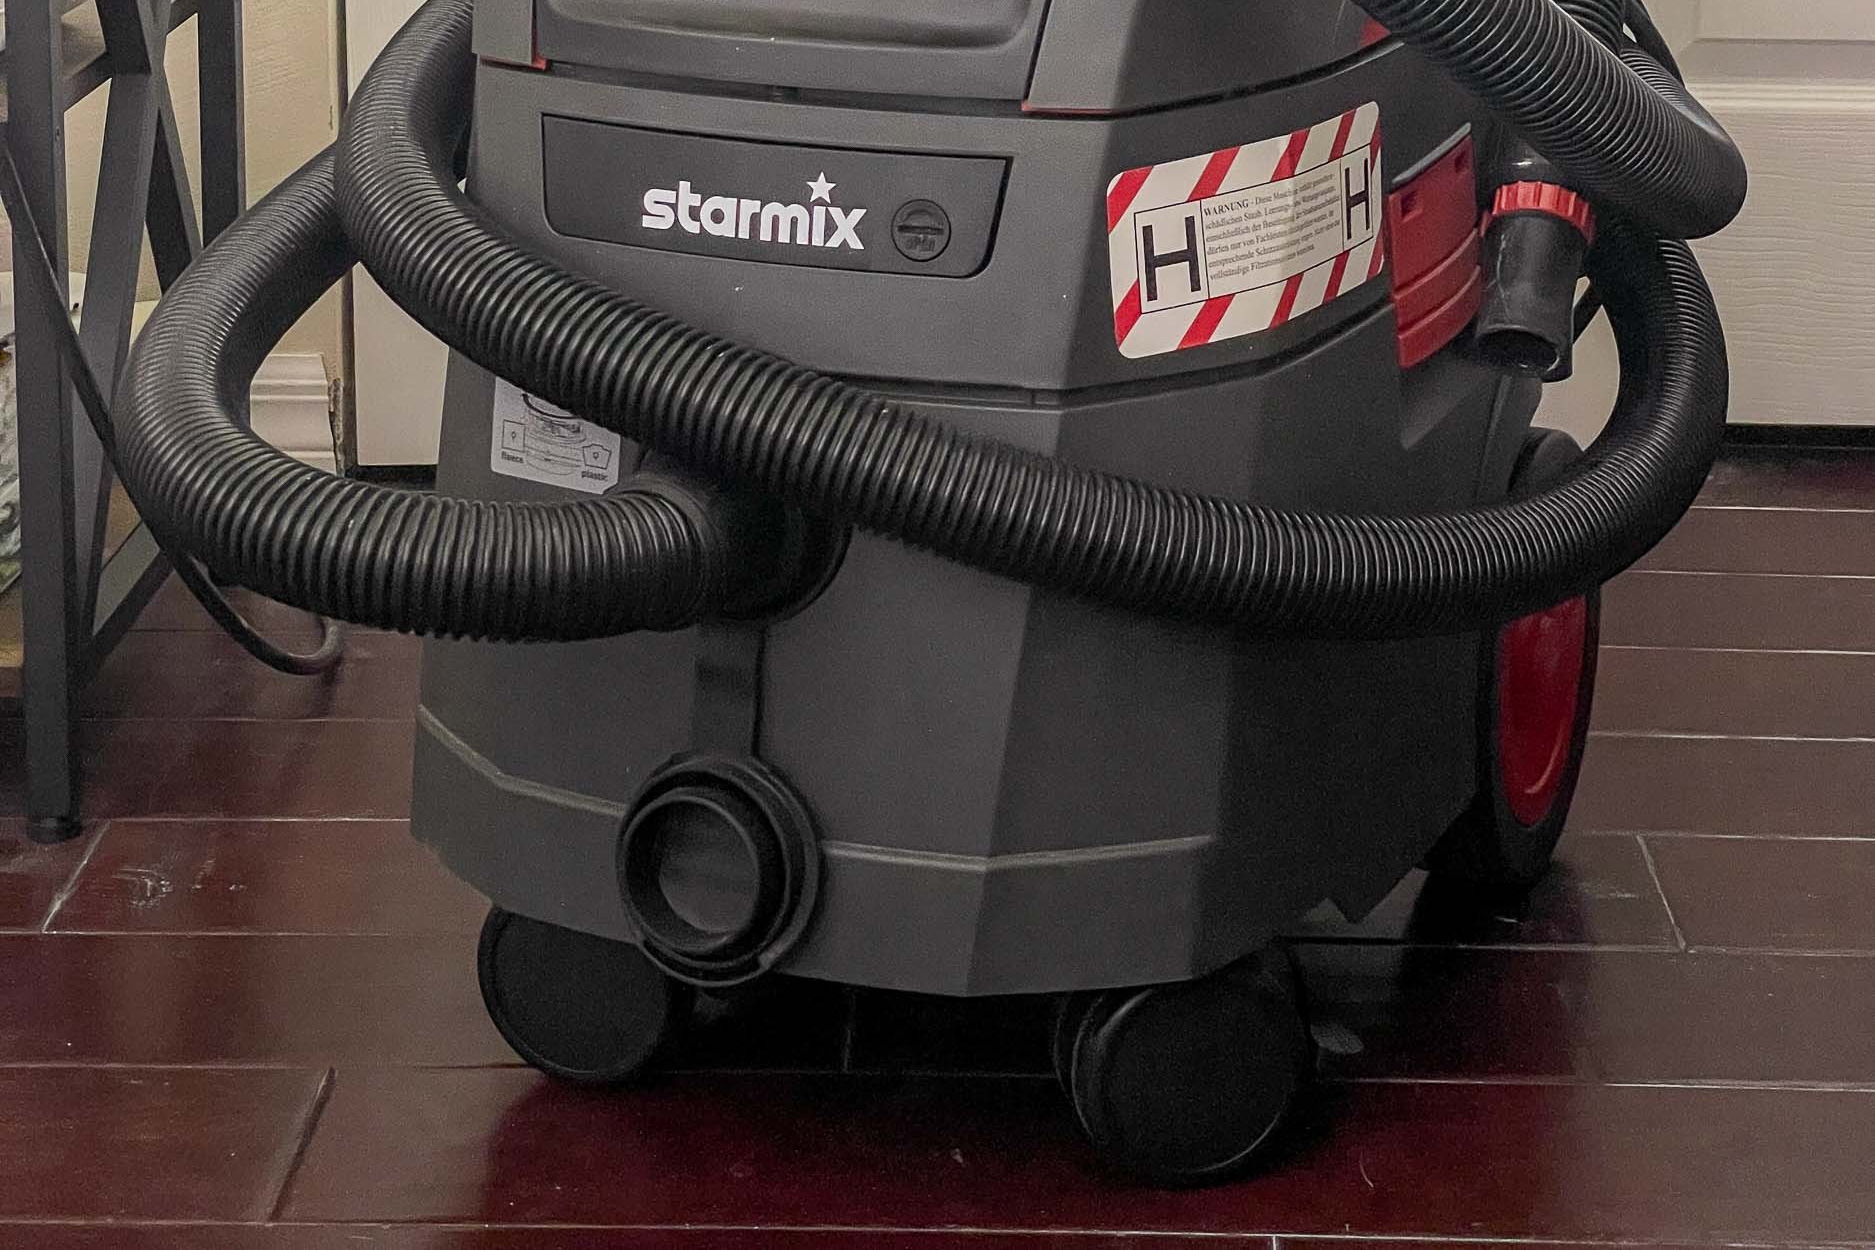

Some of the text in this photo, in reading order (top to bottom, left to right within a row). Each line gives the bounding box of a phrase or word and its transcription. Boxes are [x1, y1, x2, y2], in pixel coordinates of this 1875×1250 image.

[642, 171, 867, 250] starmix
[1203, 199, 1249, 216] WARNUNG
[1344, 157, 1371, 240] H
[1142, 215, 1201, 302] H
